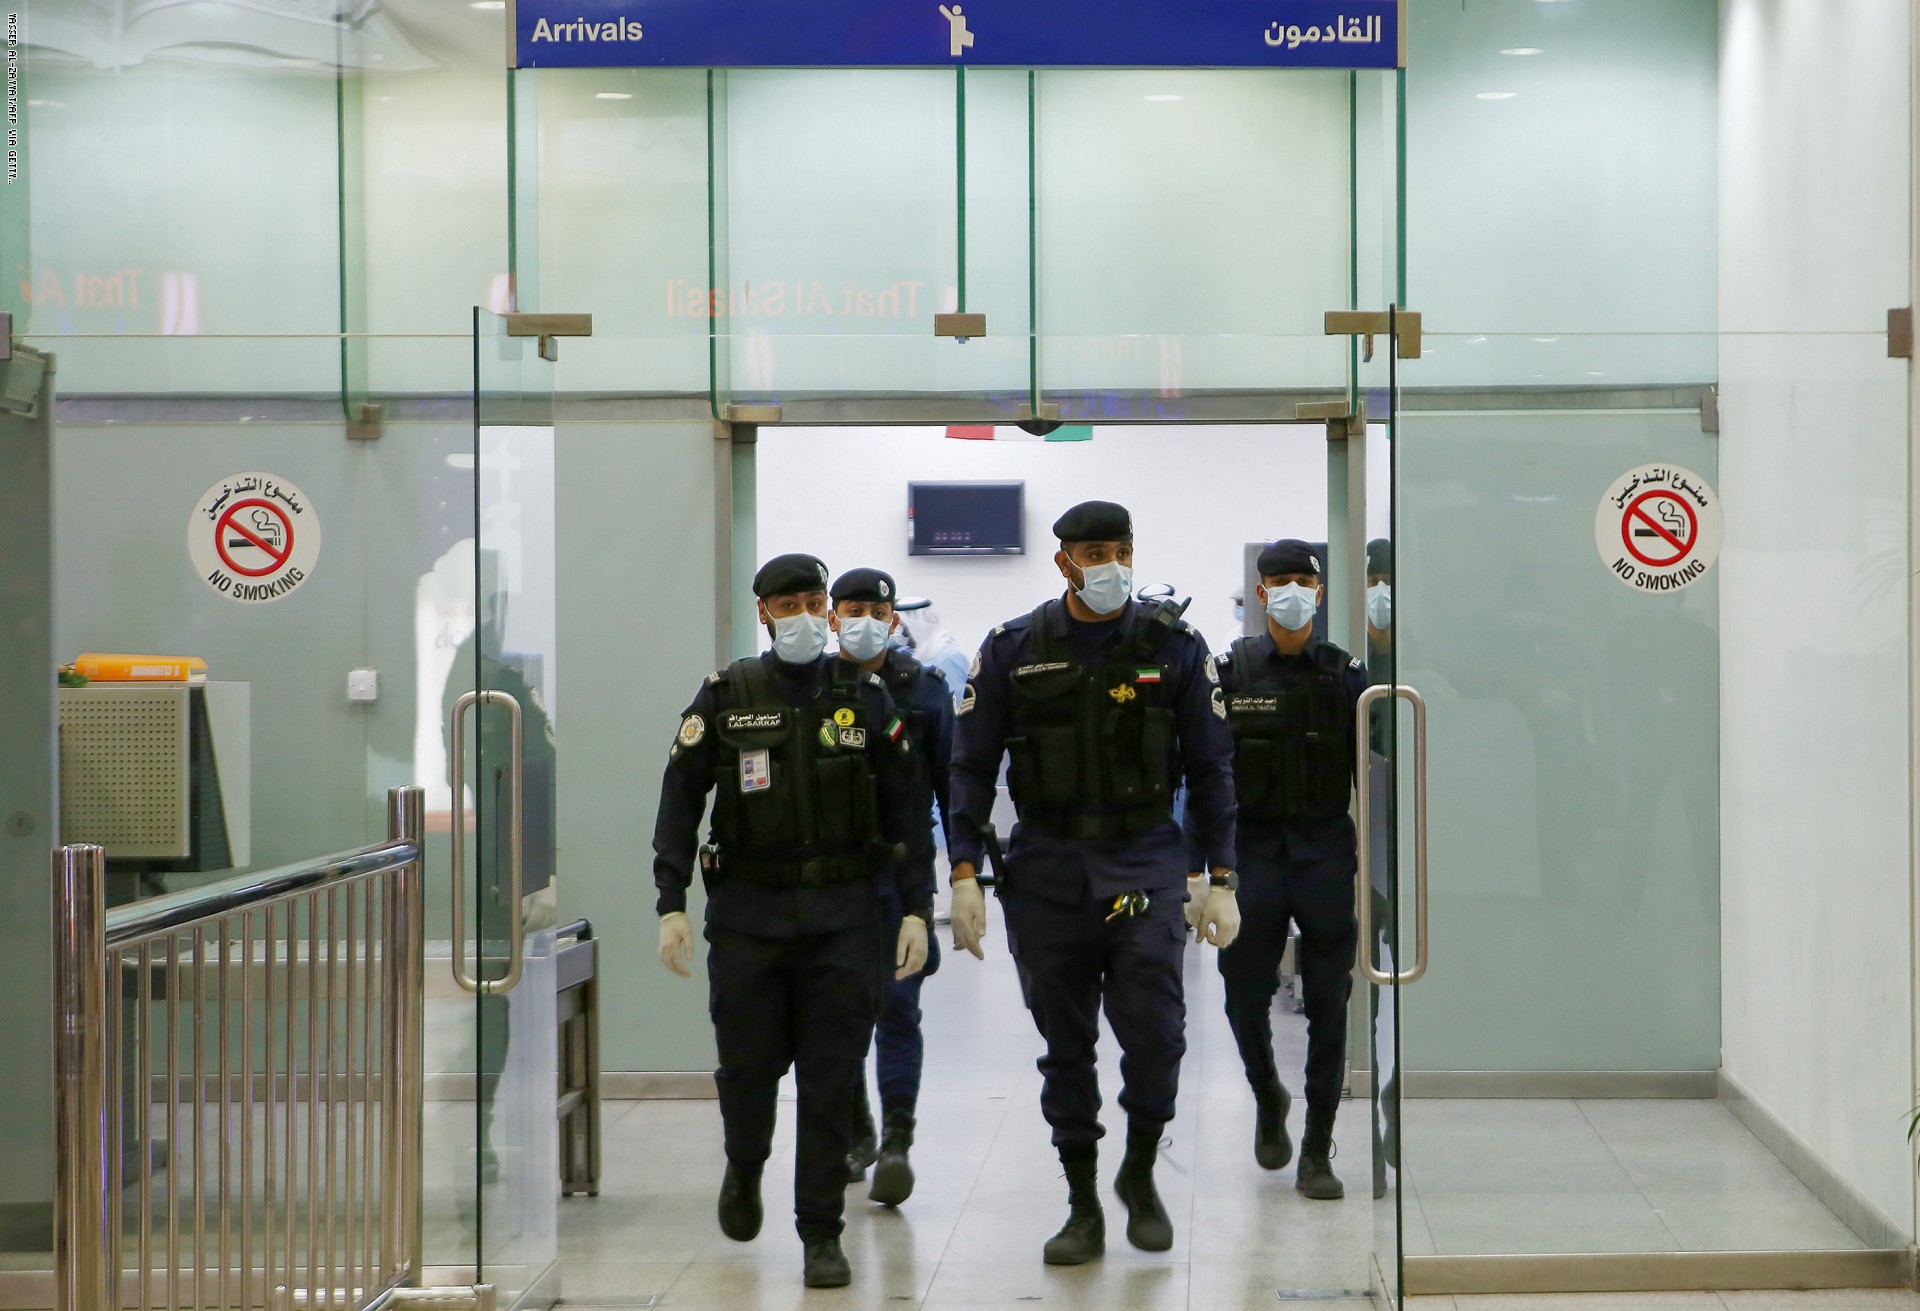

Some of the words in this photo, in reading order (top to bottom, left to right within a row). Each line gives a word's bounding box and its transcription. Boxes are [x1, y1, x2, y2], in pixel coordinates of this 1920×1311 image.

[531, 16, 643, 42] Arrivals
[1264, 14, 1381, 50] القادمون
[203, 477, 262, 520] التدخين
[264, 481, 304, 514] ممنوع
[1611, 469, 1671, 509] التدخين
[1672, 473, 1708, 507] ممنوع
[208, 569, 232, 592] NO
[233, 567, 305, 600] SMOKING
[1612, 557, 1635, 580] NO
[1635, 559, 1706, 590] SMOKING
